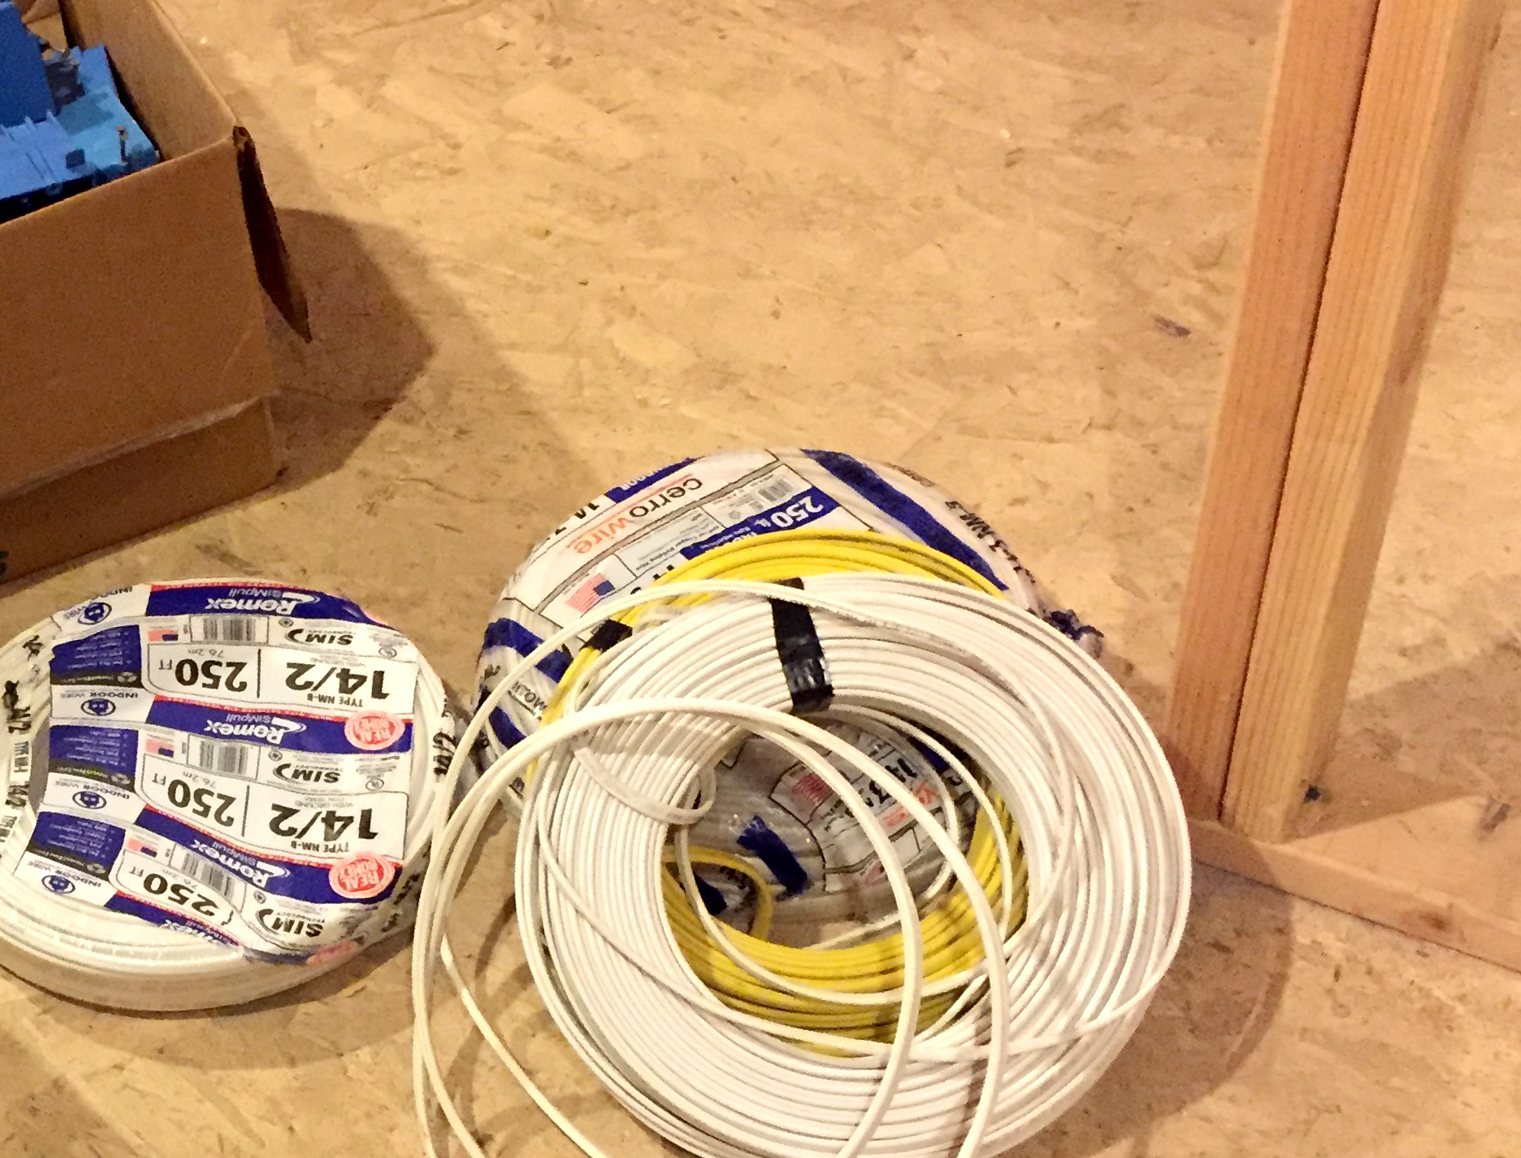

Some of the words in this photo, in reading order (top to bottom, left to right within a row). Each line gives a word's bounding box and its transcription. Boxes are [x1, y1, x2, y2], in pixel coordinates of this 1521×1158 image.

[573, 477, 703, 554] cerrowire
[770, 495, 825, 528] 250
[204, 597, 298, 616] Romex
[305, 634, 355, 646] SIM
[158, 659, 173, 671] FT
[174, 658, 248, 693] 250
[284, 661, 390, 700] 14/2
[338, 698, 364, 708] TYPE
[203, 719, 287, 745] Romex
[151, 772, 167, 786] FT
[291, 770, 341, 784] SIM
[167, 778, 237, 828] 250
[268, 802, 379, 842] 14/2
[323, 841, 350, 853] TYPE
[128, 865, 145, 878] FT
[189, 839, 271, 889] Romex
[143, 872, 220, 917] 250
[271, 916, 325, 938] SIM
